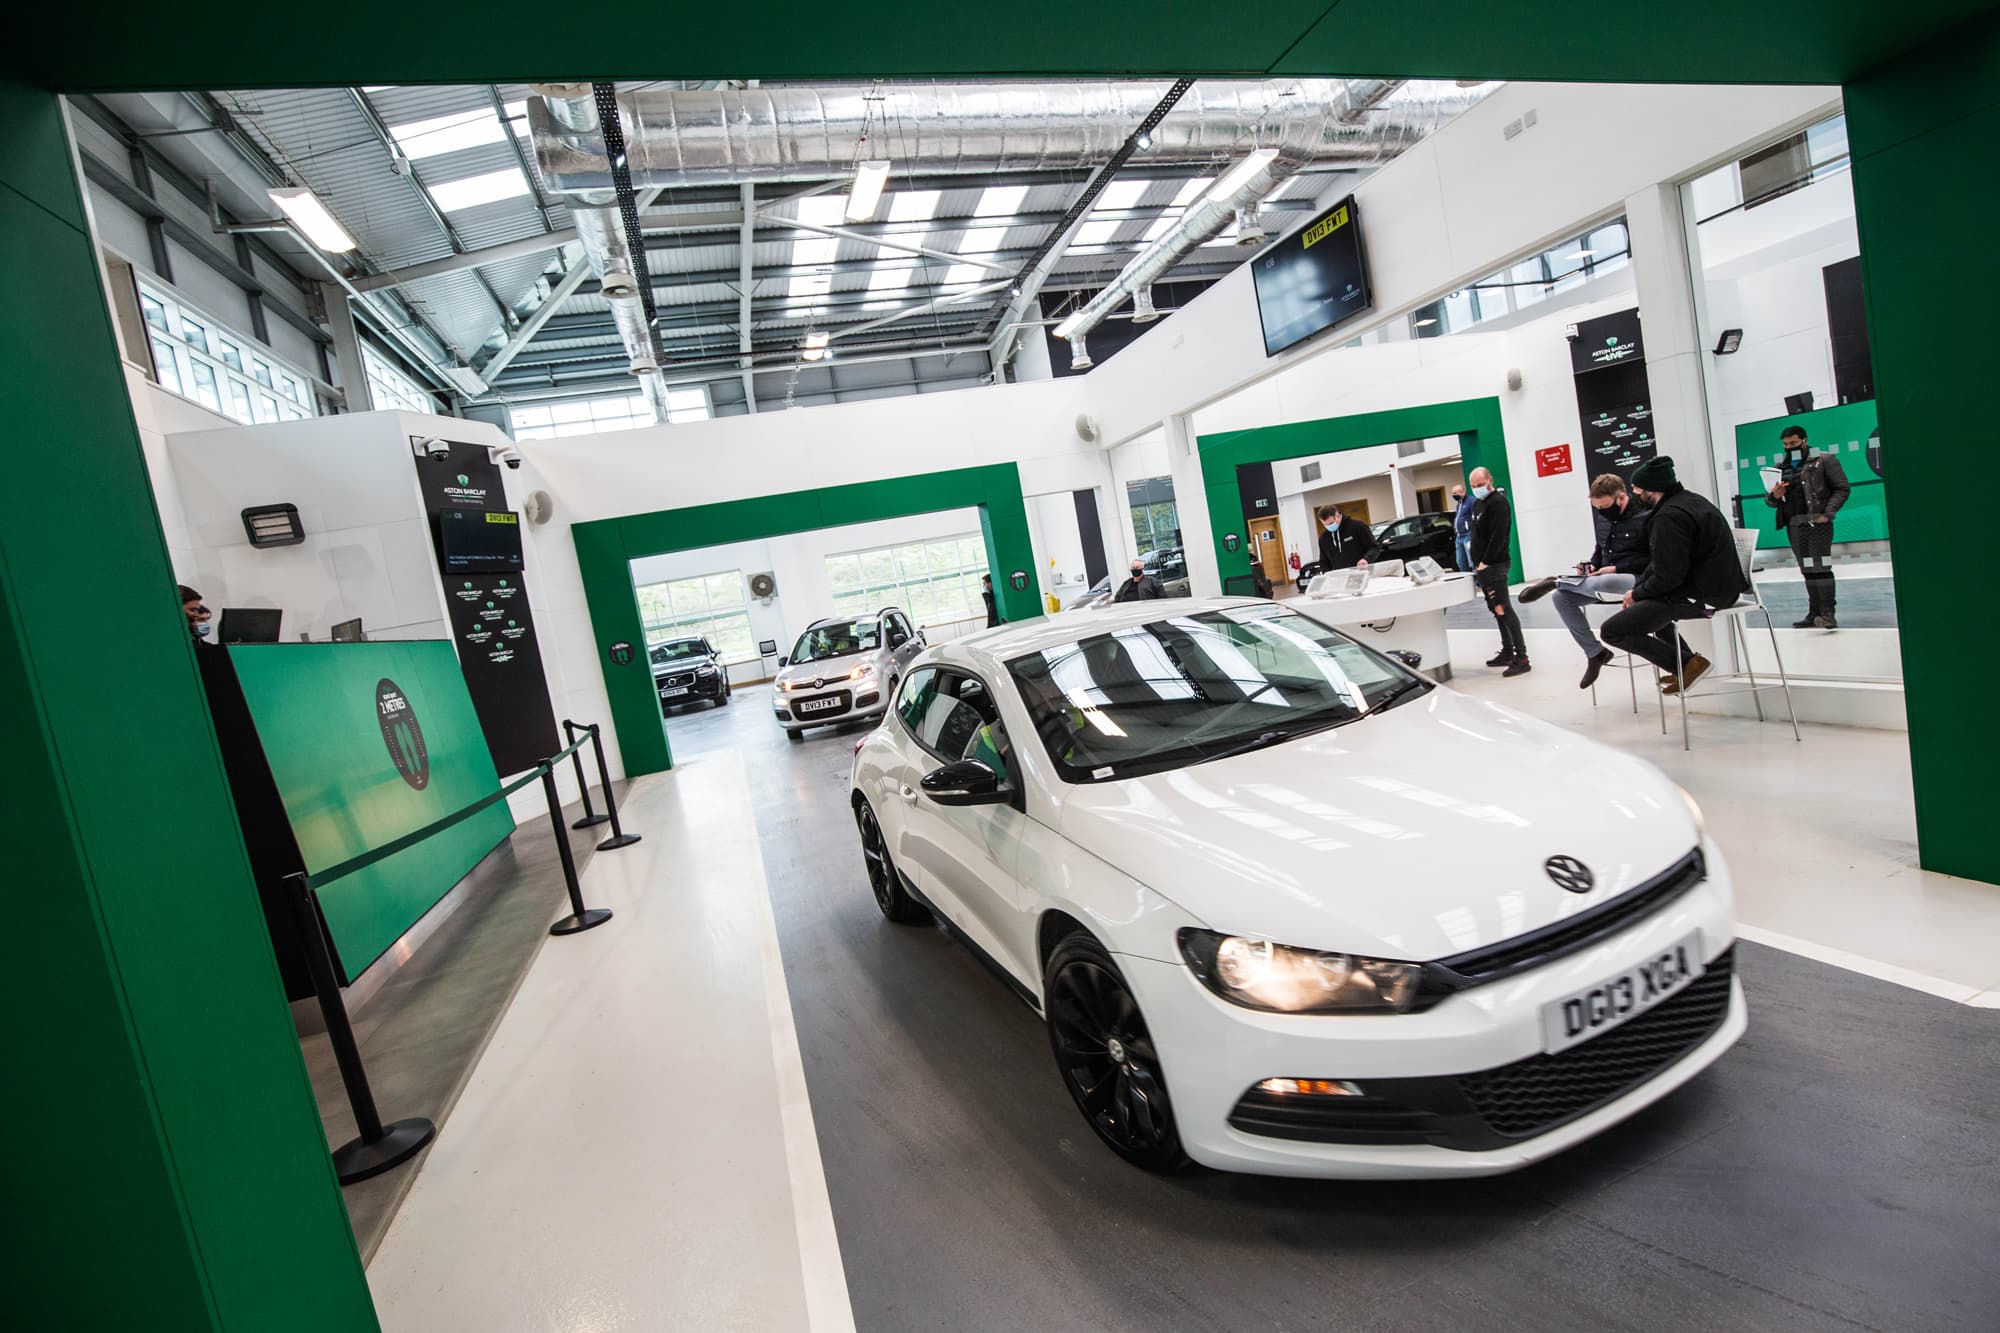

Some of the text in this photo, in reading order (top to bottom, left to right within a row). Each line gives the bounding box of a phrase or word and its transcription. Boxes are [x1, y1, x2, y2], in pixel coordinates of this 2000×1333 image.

[1307, 225, 1325, 244] DV13
[1592, 342, 1635, 357] ASTON BARCLAY
[1605, 351, 1623, 361] LIVE
[380, 697, 406, 714] 2 METRES
[805, 698, 836, 710] DV13 FWT
[1562, 946, 1691, 1038] DG13 XGA
